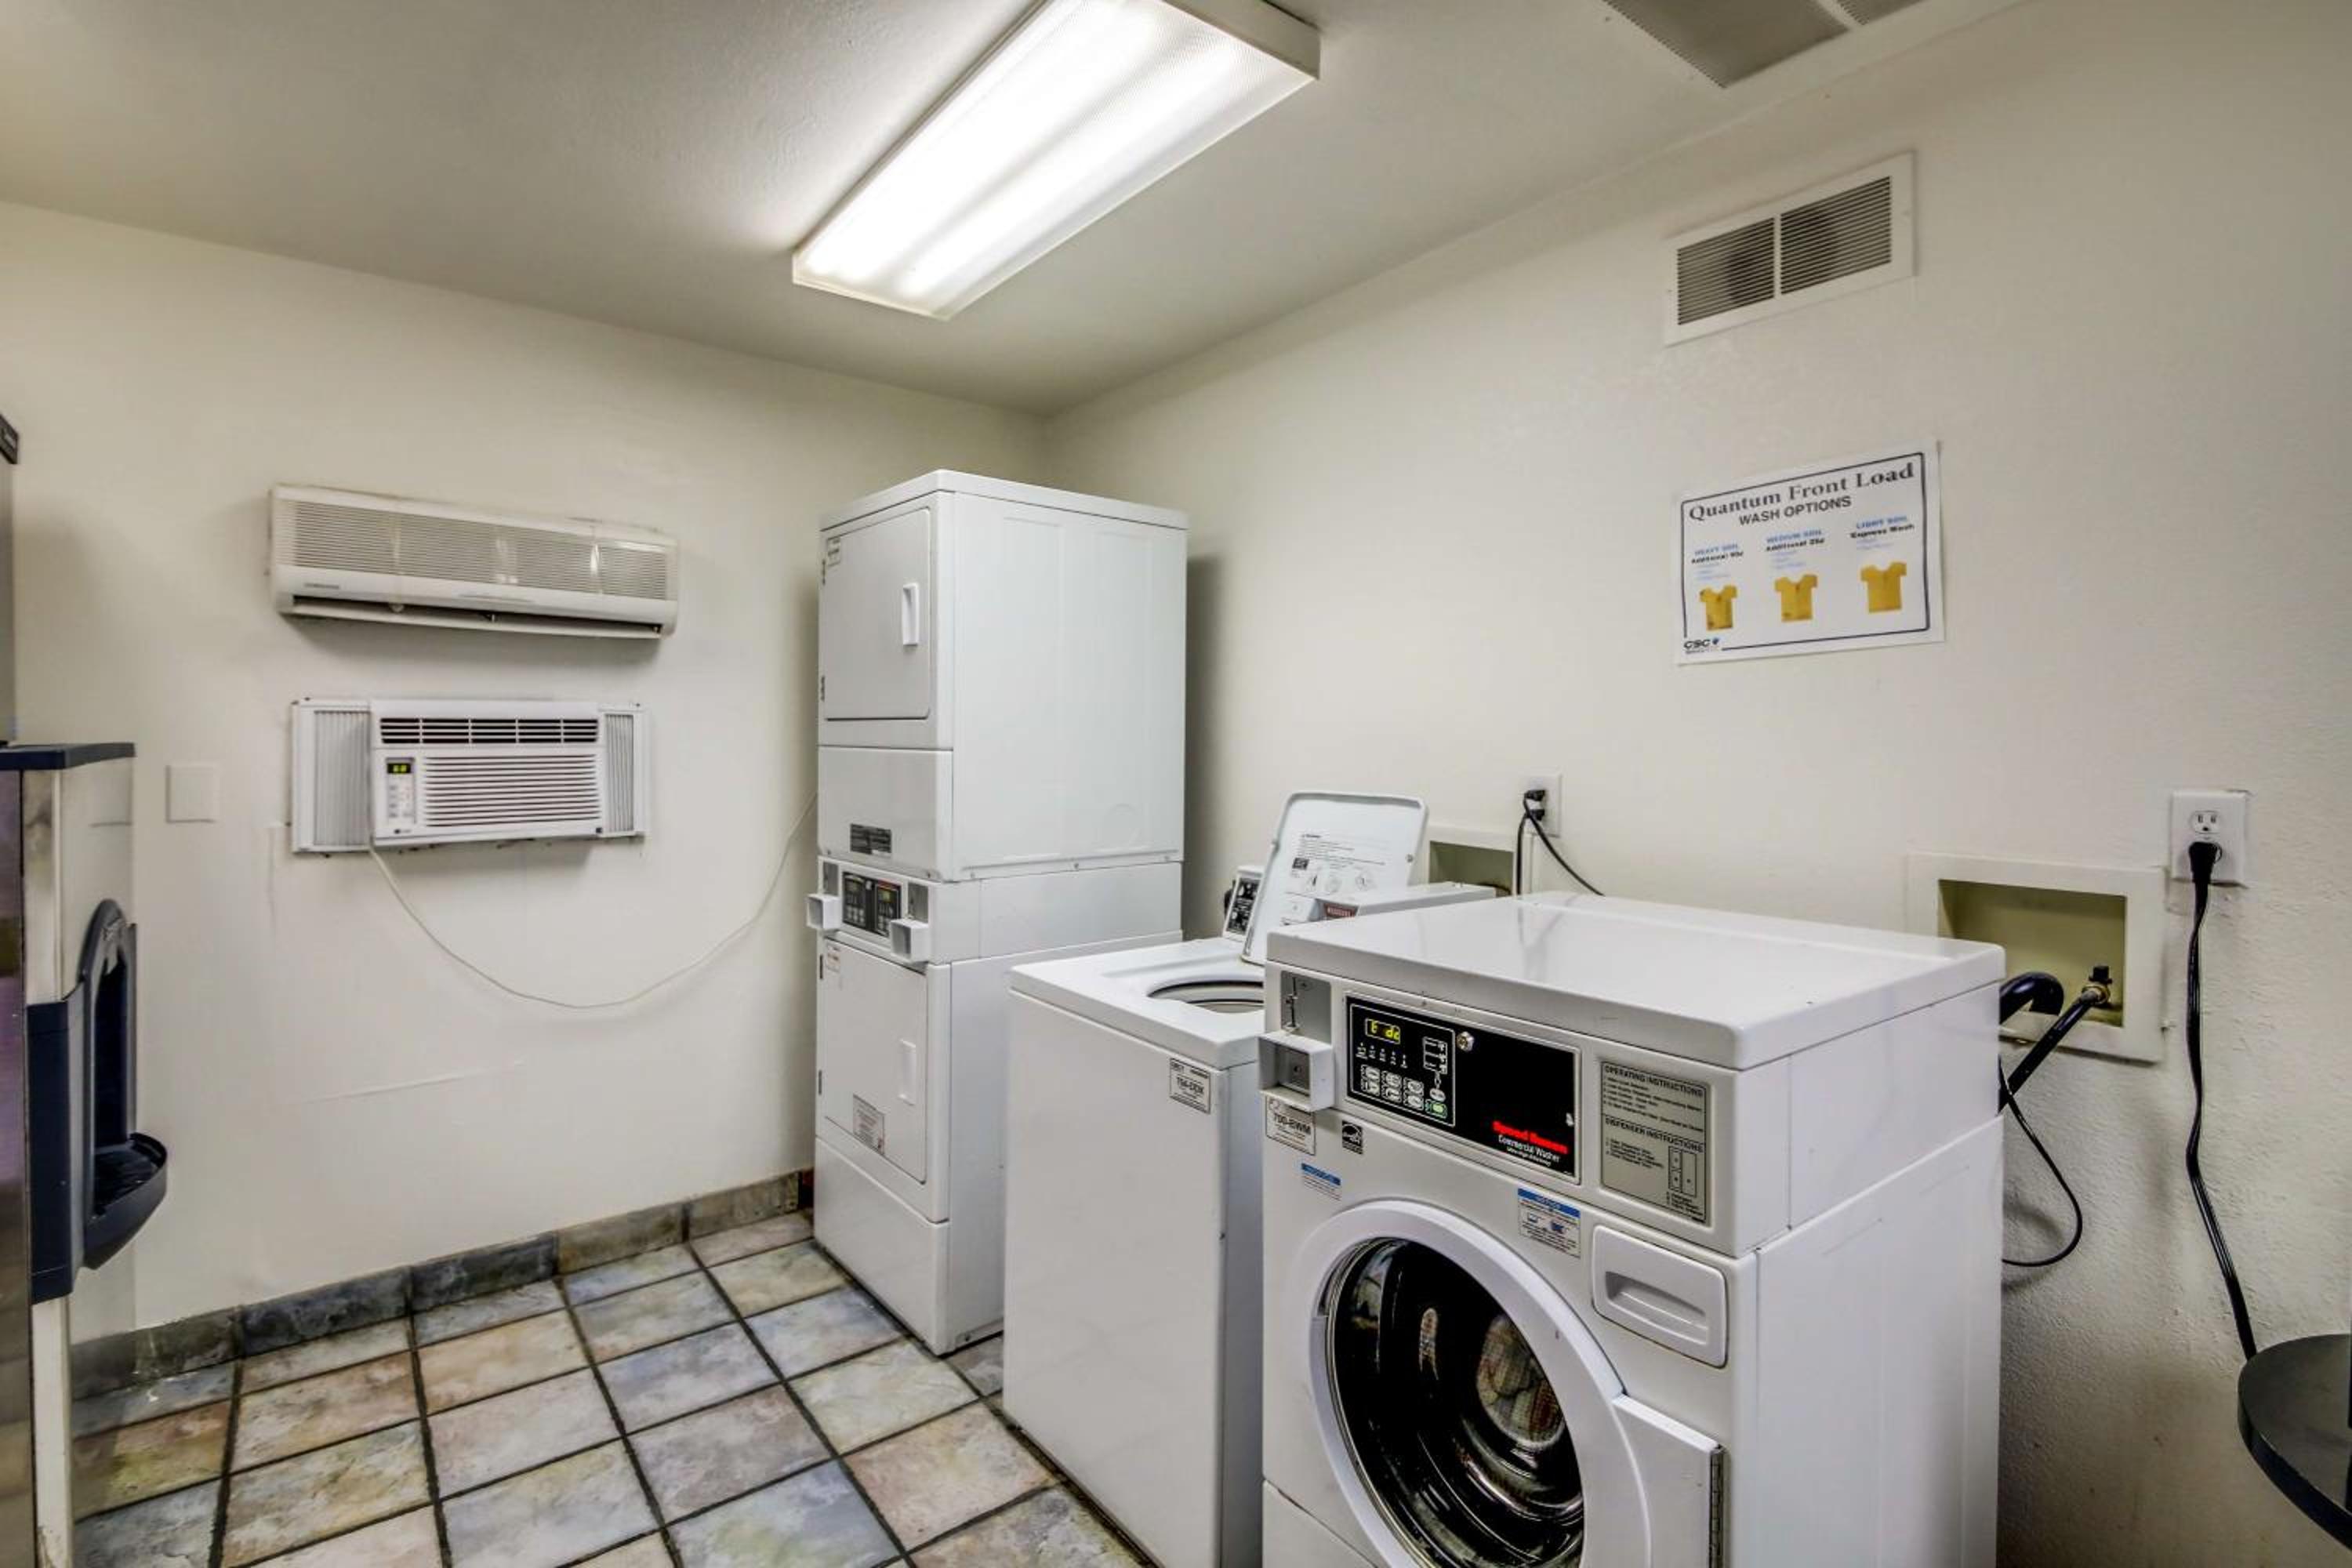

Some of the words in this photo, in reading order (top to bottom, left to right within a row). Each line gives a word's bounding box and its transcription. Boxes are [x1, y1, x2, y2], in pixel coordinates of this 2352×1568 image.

[1689, 493, 1781, 521] Quantum
[1788, 478, 1847, 500] Front
[1856, 462, 1915, 488] Load
[1738, 509, 1780, 525] WASH
[1784, 495, 1852, 517] OPTIONS
[1605, 1065, 1646, 1083] OPERATING
[1648, 1076, 1703, 1098] INSTRUCTIONS
